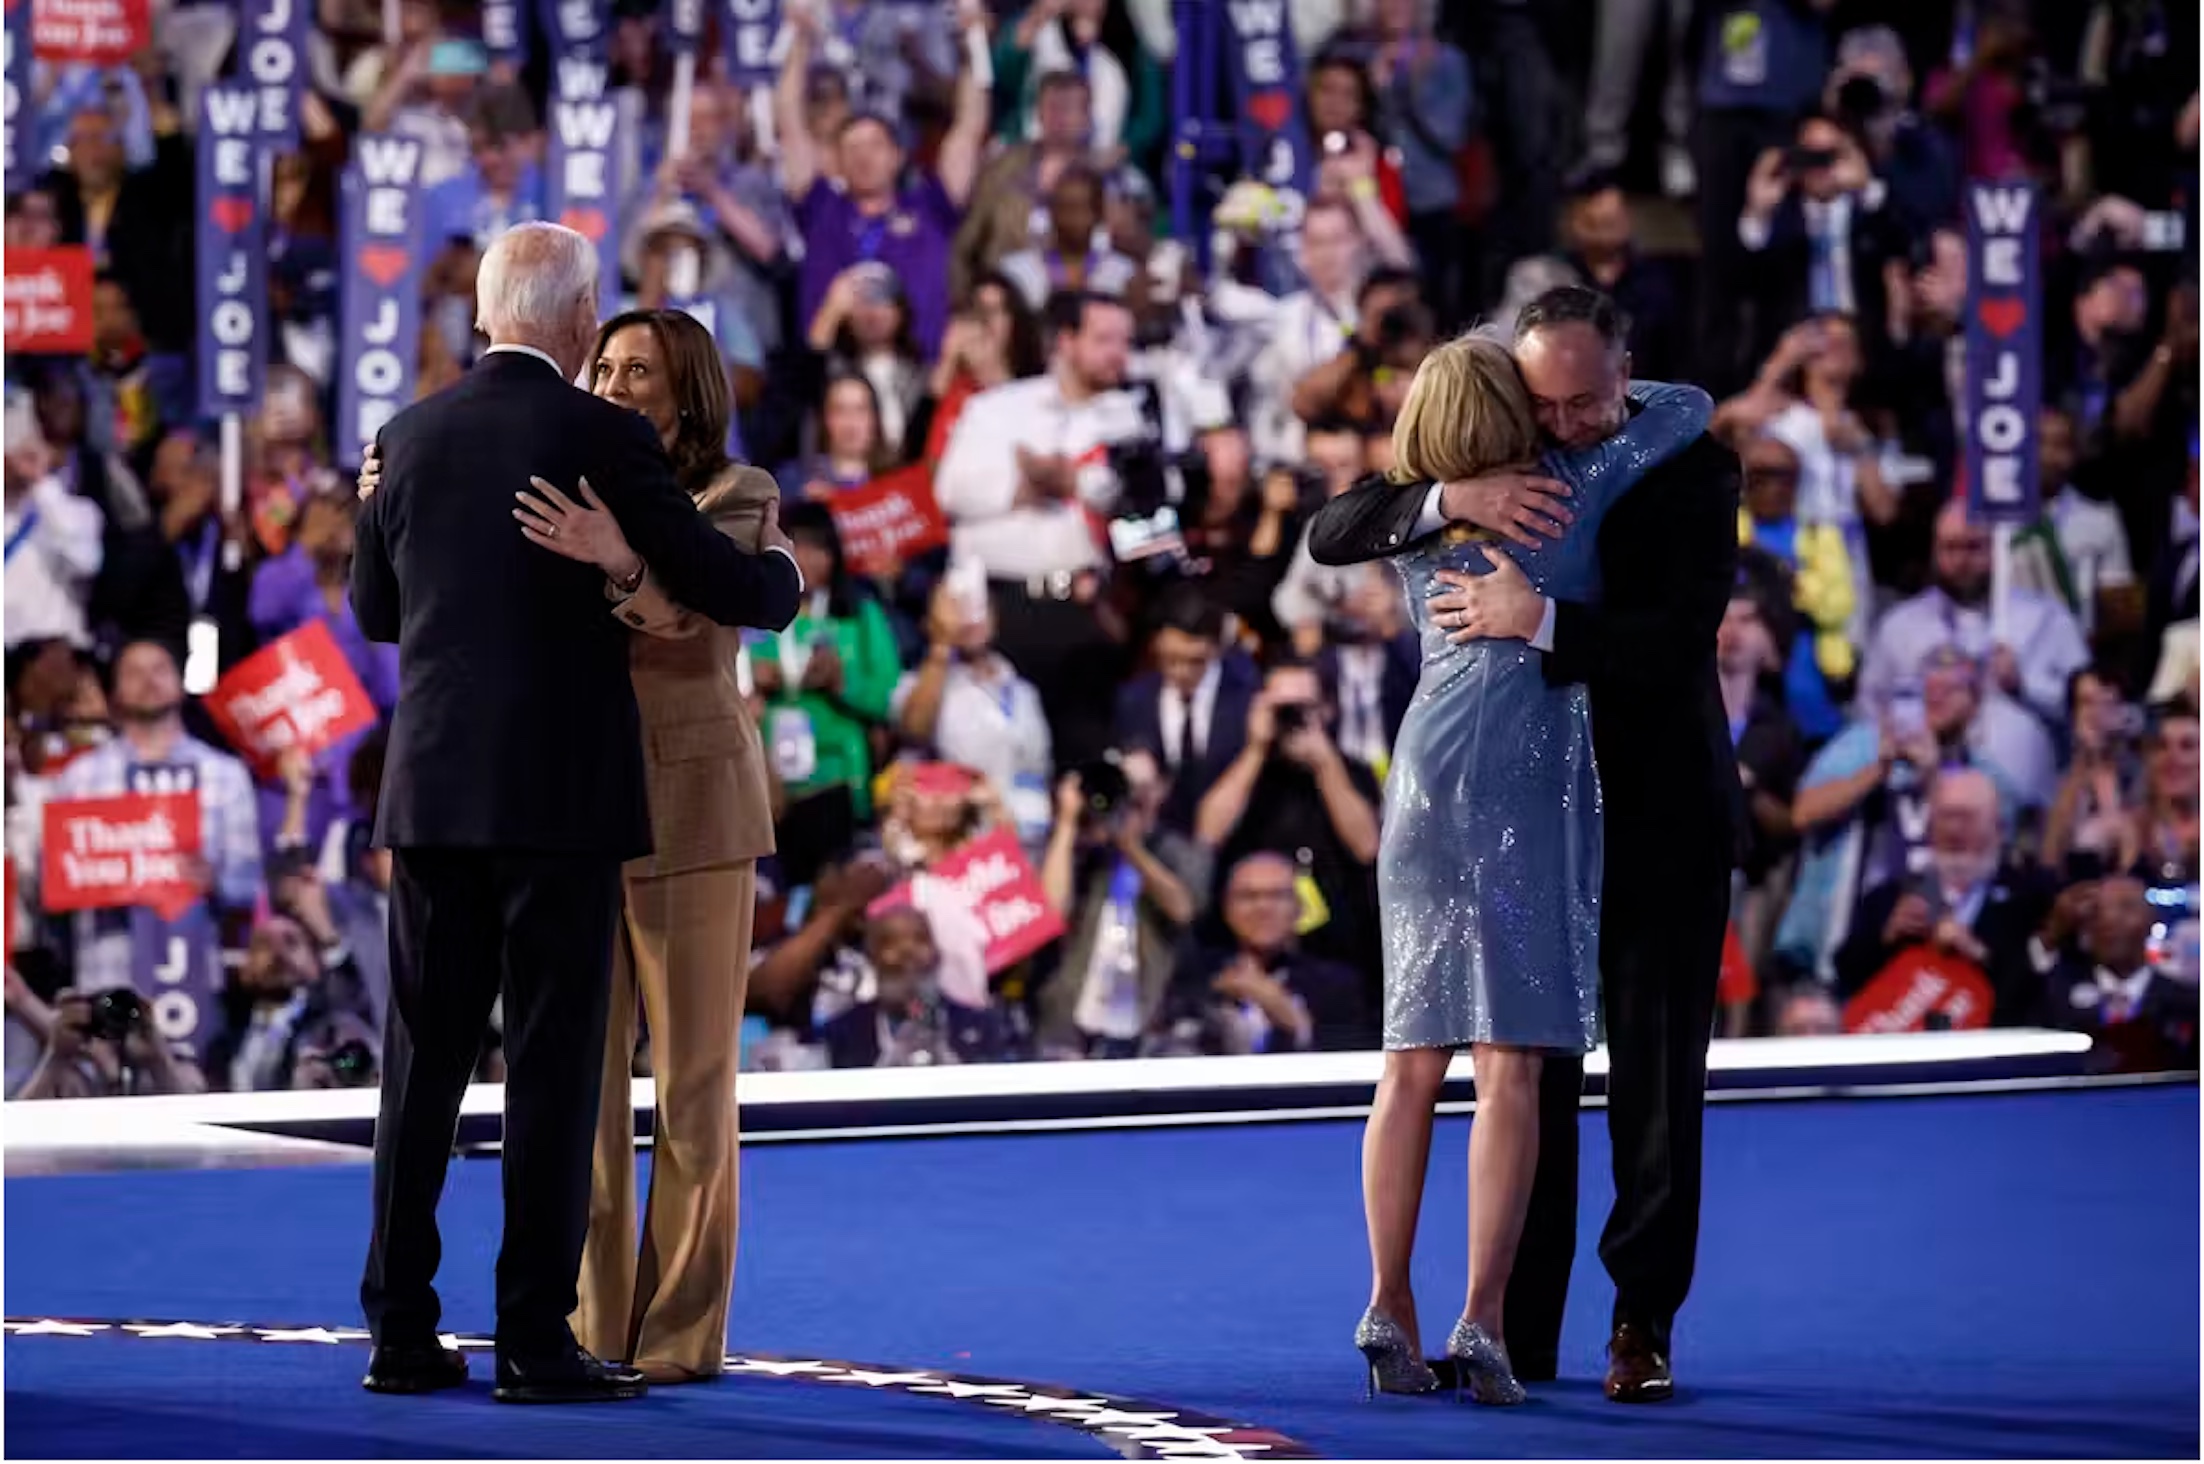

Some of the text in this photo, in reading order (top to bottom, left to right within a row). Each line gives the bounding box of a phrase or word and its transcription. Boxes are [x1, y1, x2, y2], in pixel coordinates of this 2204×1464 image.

[1228, 0, 1284, 83] WE
[359, 137, 418, 234] WE
[556, 102, 616, 198] WE
[206, 88, 256, 396] WE JOE
[1973, 186, 2032, 503] WE JOE
[62, 811, 177, 855] Thank
[62, 850, 128, 889] You
